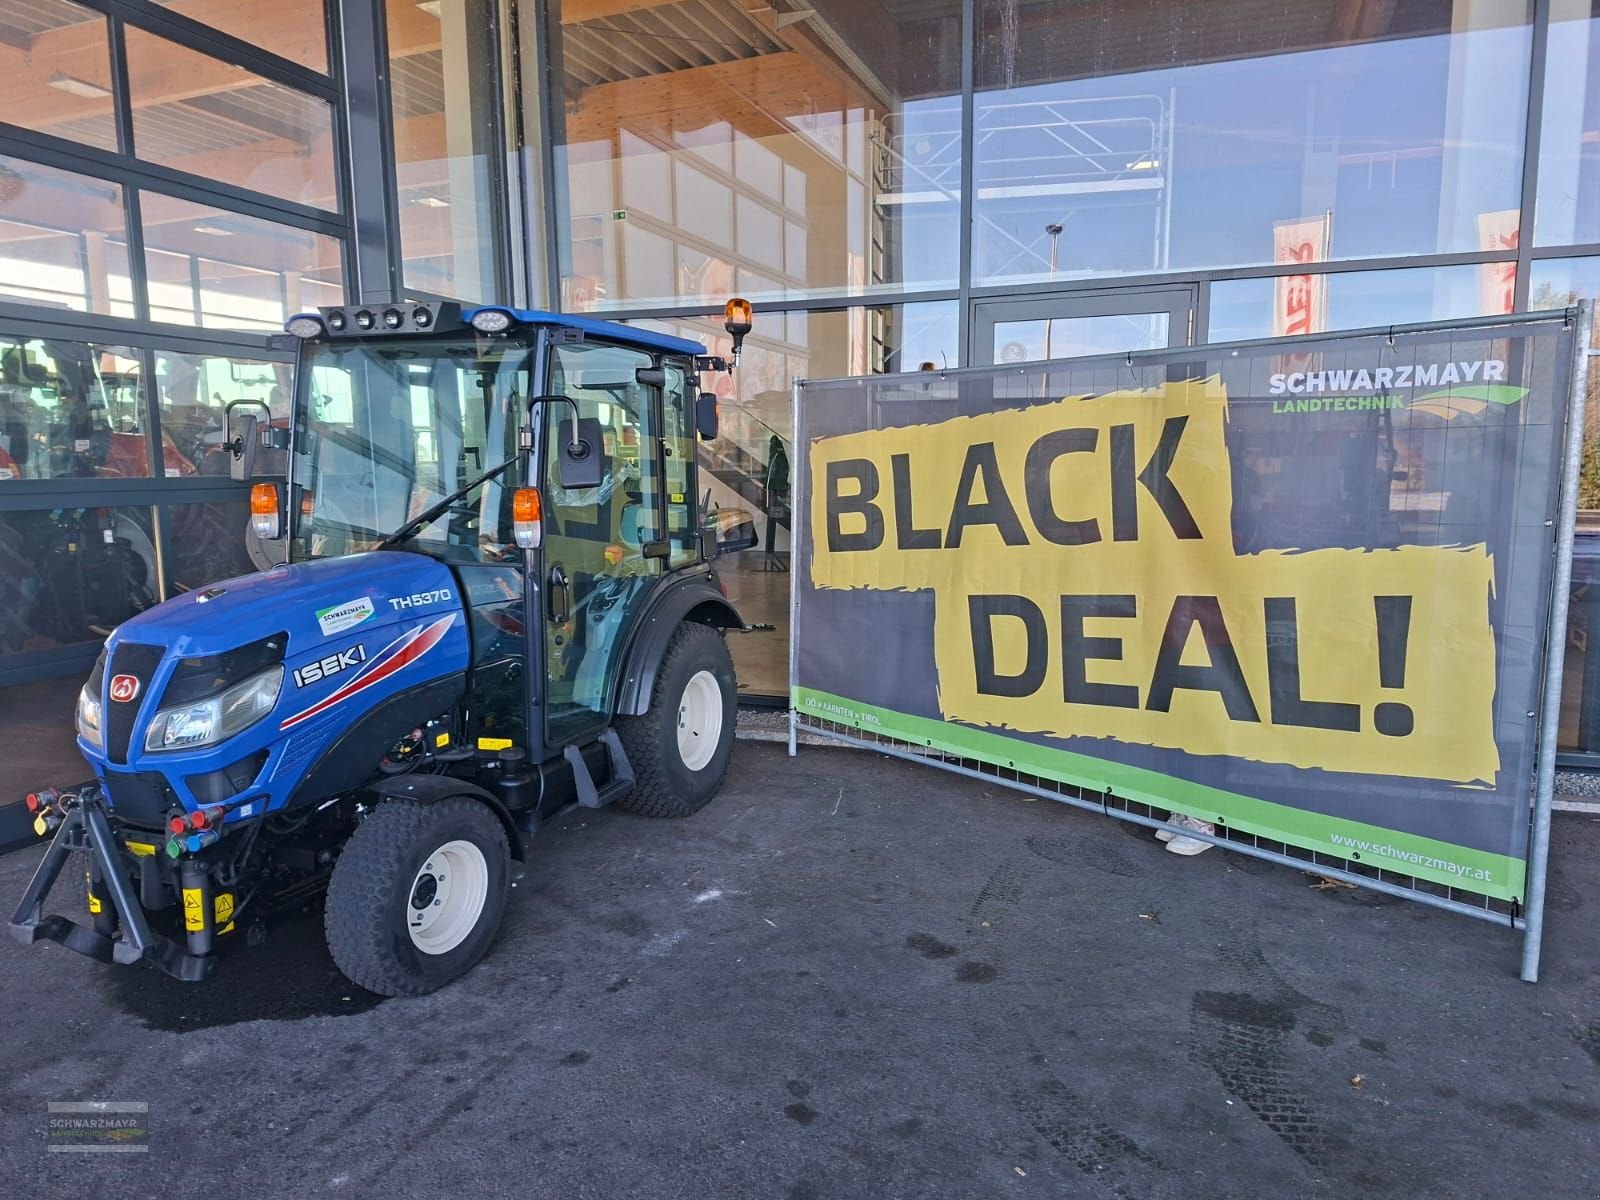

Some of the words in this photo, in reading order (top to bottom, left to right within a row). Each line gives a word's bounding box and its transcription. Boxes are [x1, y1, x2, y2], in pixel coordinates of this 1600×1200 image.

[1269, 359, 1505, 394] SCHWARZMAYR
[1272, 394, 1405, 414] LANDTECHNIK
[825, 414, 1204, 553] BLACK
[388, 588, 452, 610] TH5370
[292, 643, 367, 689] ISEKI
[967, 594, 1415, 737] DEAL!
[861, 712, 881, 726] TIROL
[1330, 832, 1493, 883] www.schwarzmayr.at
